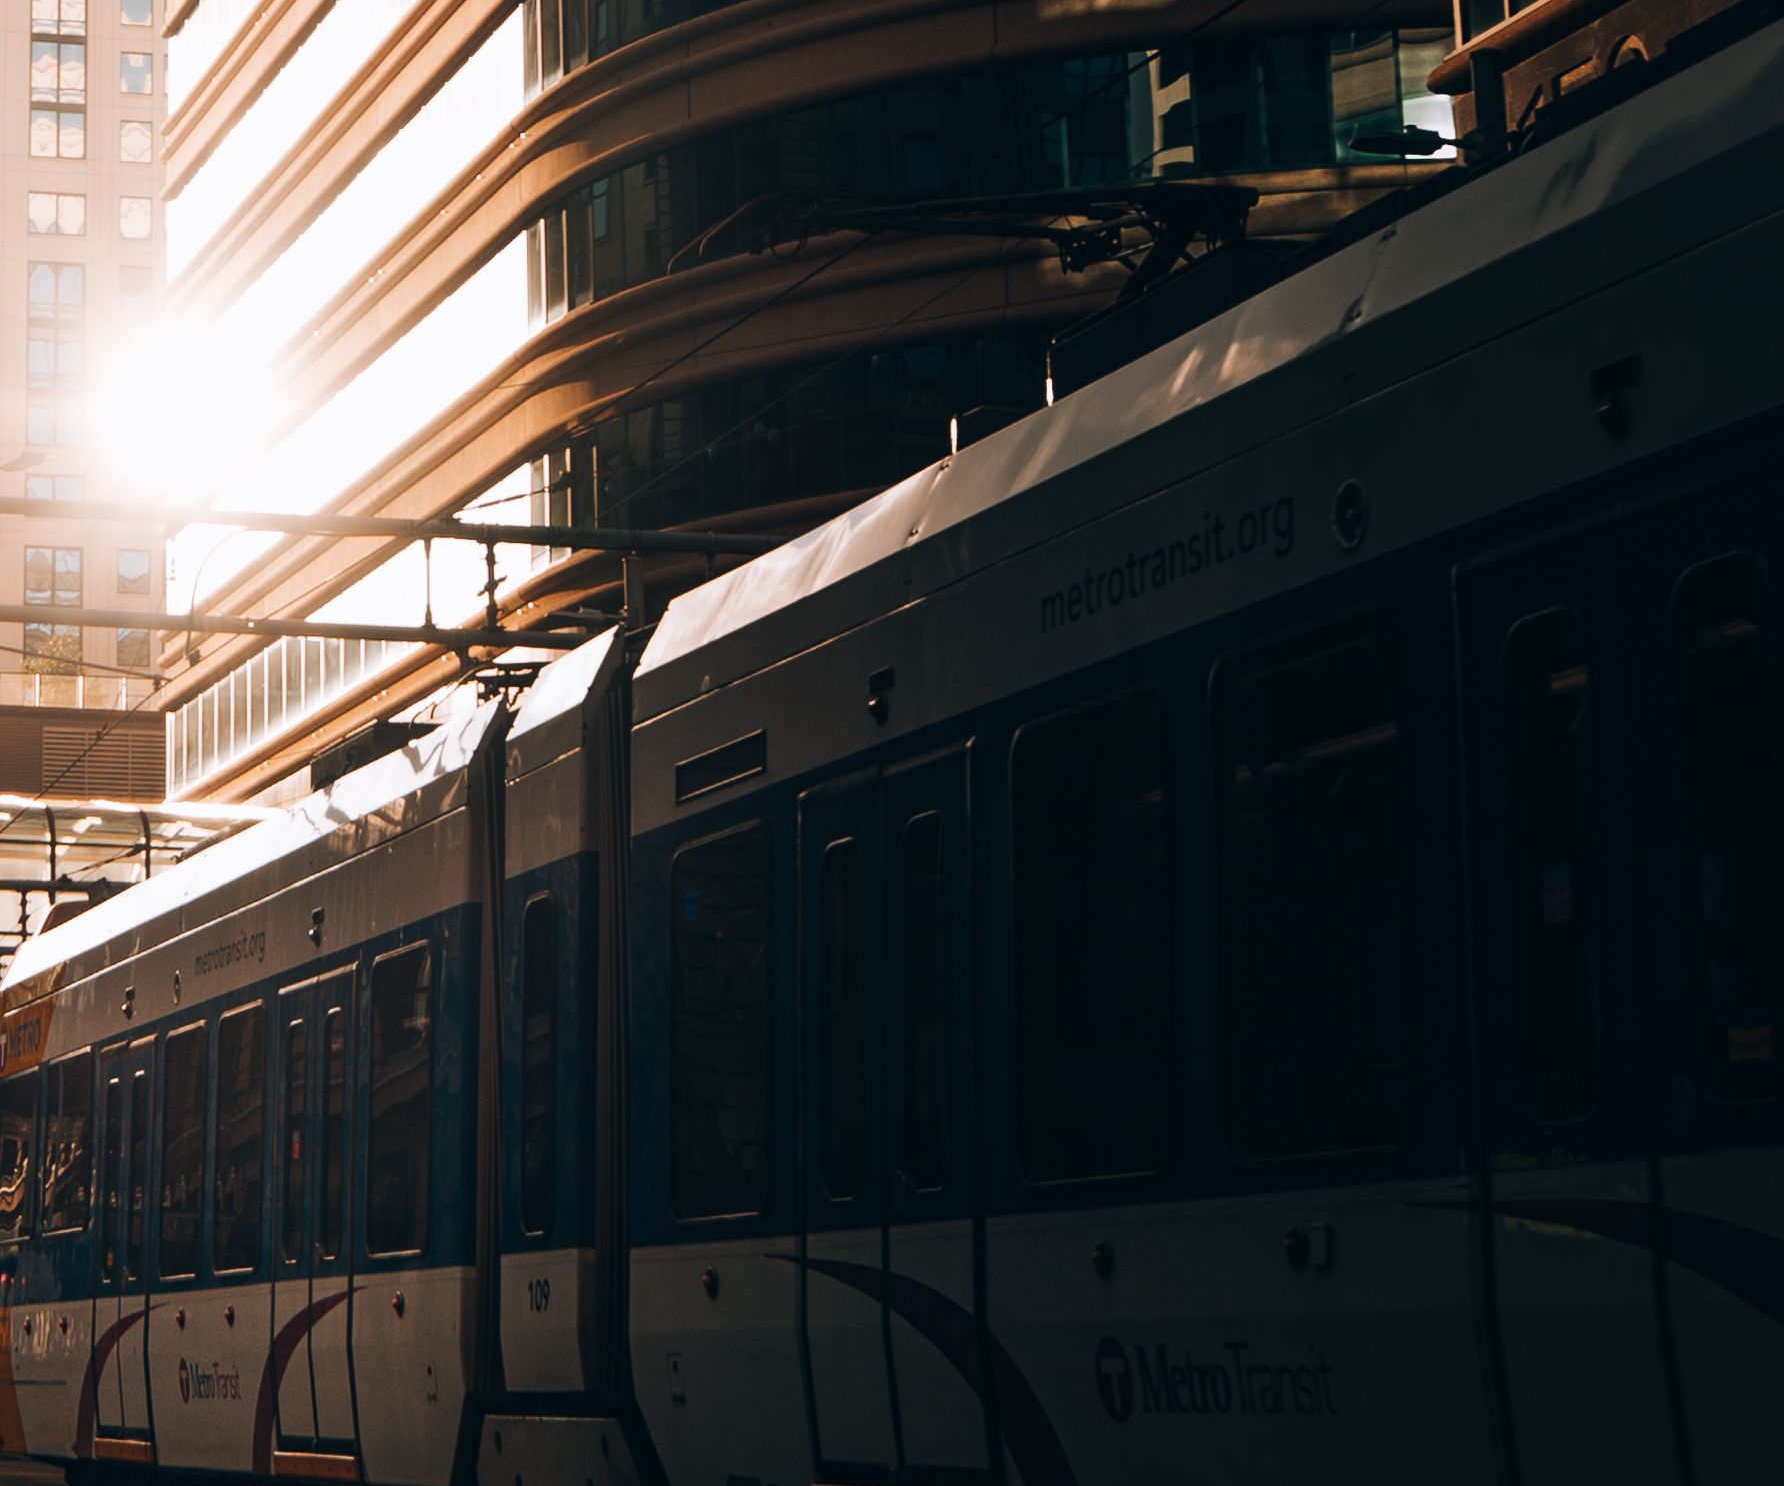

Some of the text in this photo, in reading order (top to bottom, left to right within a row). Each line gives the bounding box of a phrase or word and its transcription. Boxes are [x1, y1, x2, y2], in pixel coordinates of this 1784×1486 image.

[1040, 495, 1295, 634] metrotransit.org
[194, 930, 265, 977] metrotransit.org
[528, 1279, 550, 1312] 109
